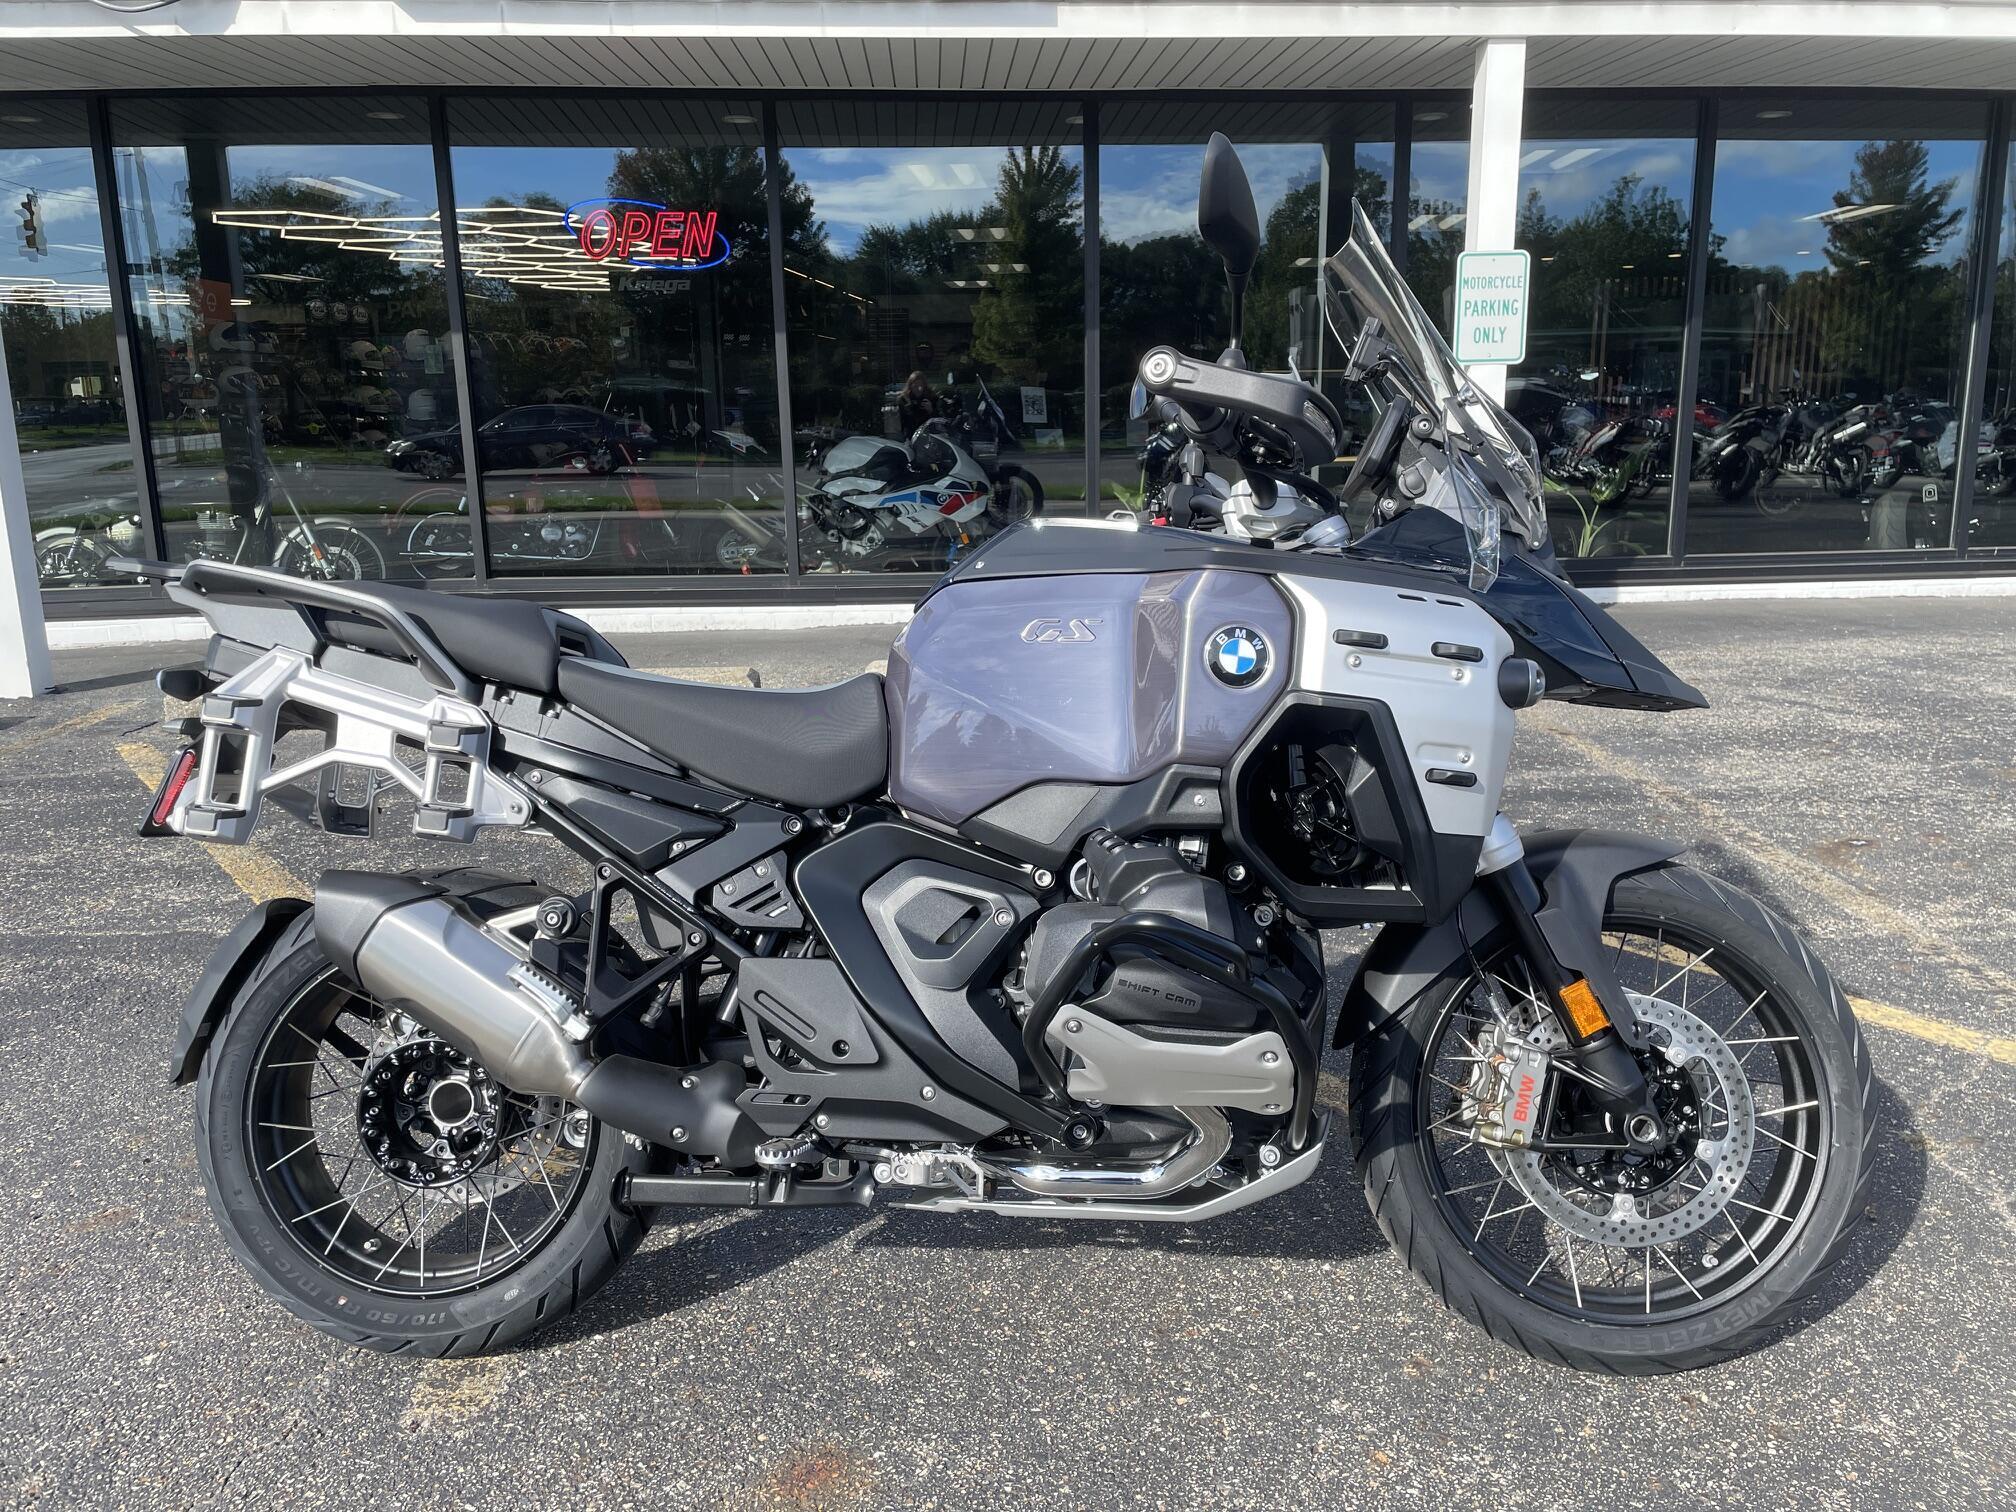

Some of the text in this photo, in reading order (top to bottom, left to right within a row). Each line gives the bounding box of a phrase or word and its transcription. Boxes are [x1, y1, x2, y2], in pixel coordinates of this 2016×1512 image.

[581, 209, 717, 259] OPEN
[618, 277, 691, 294] Kriega
[1463, 276, 1523, 289] MOTORCYCLE
[1464, 299, 1519, 317] PARKING
[1473, 326, 1508, 343] ONLY
[1020, 618, 1104, 643] GS
[1216, 628, 1265, 651] BMW
[1117, 978, 1197, 1007] SHIFT CAM
[1513, 1074, 1535, 1121] BMW
